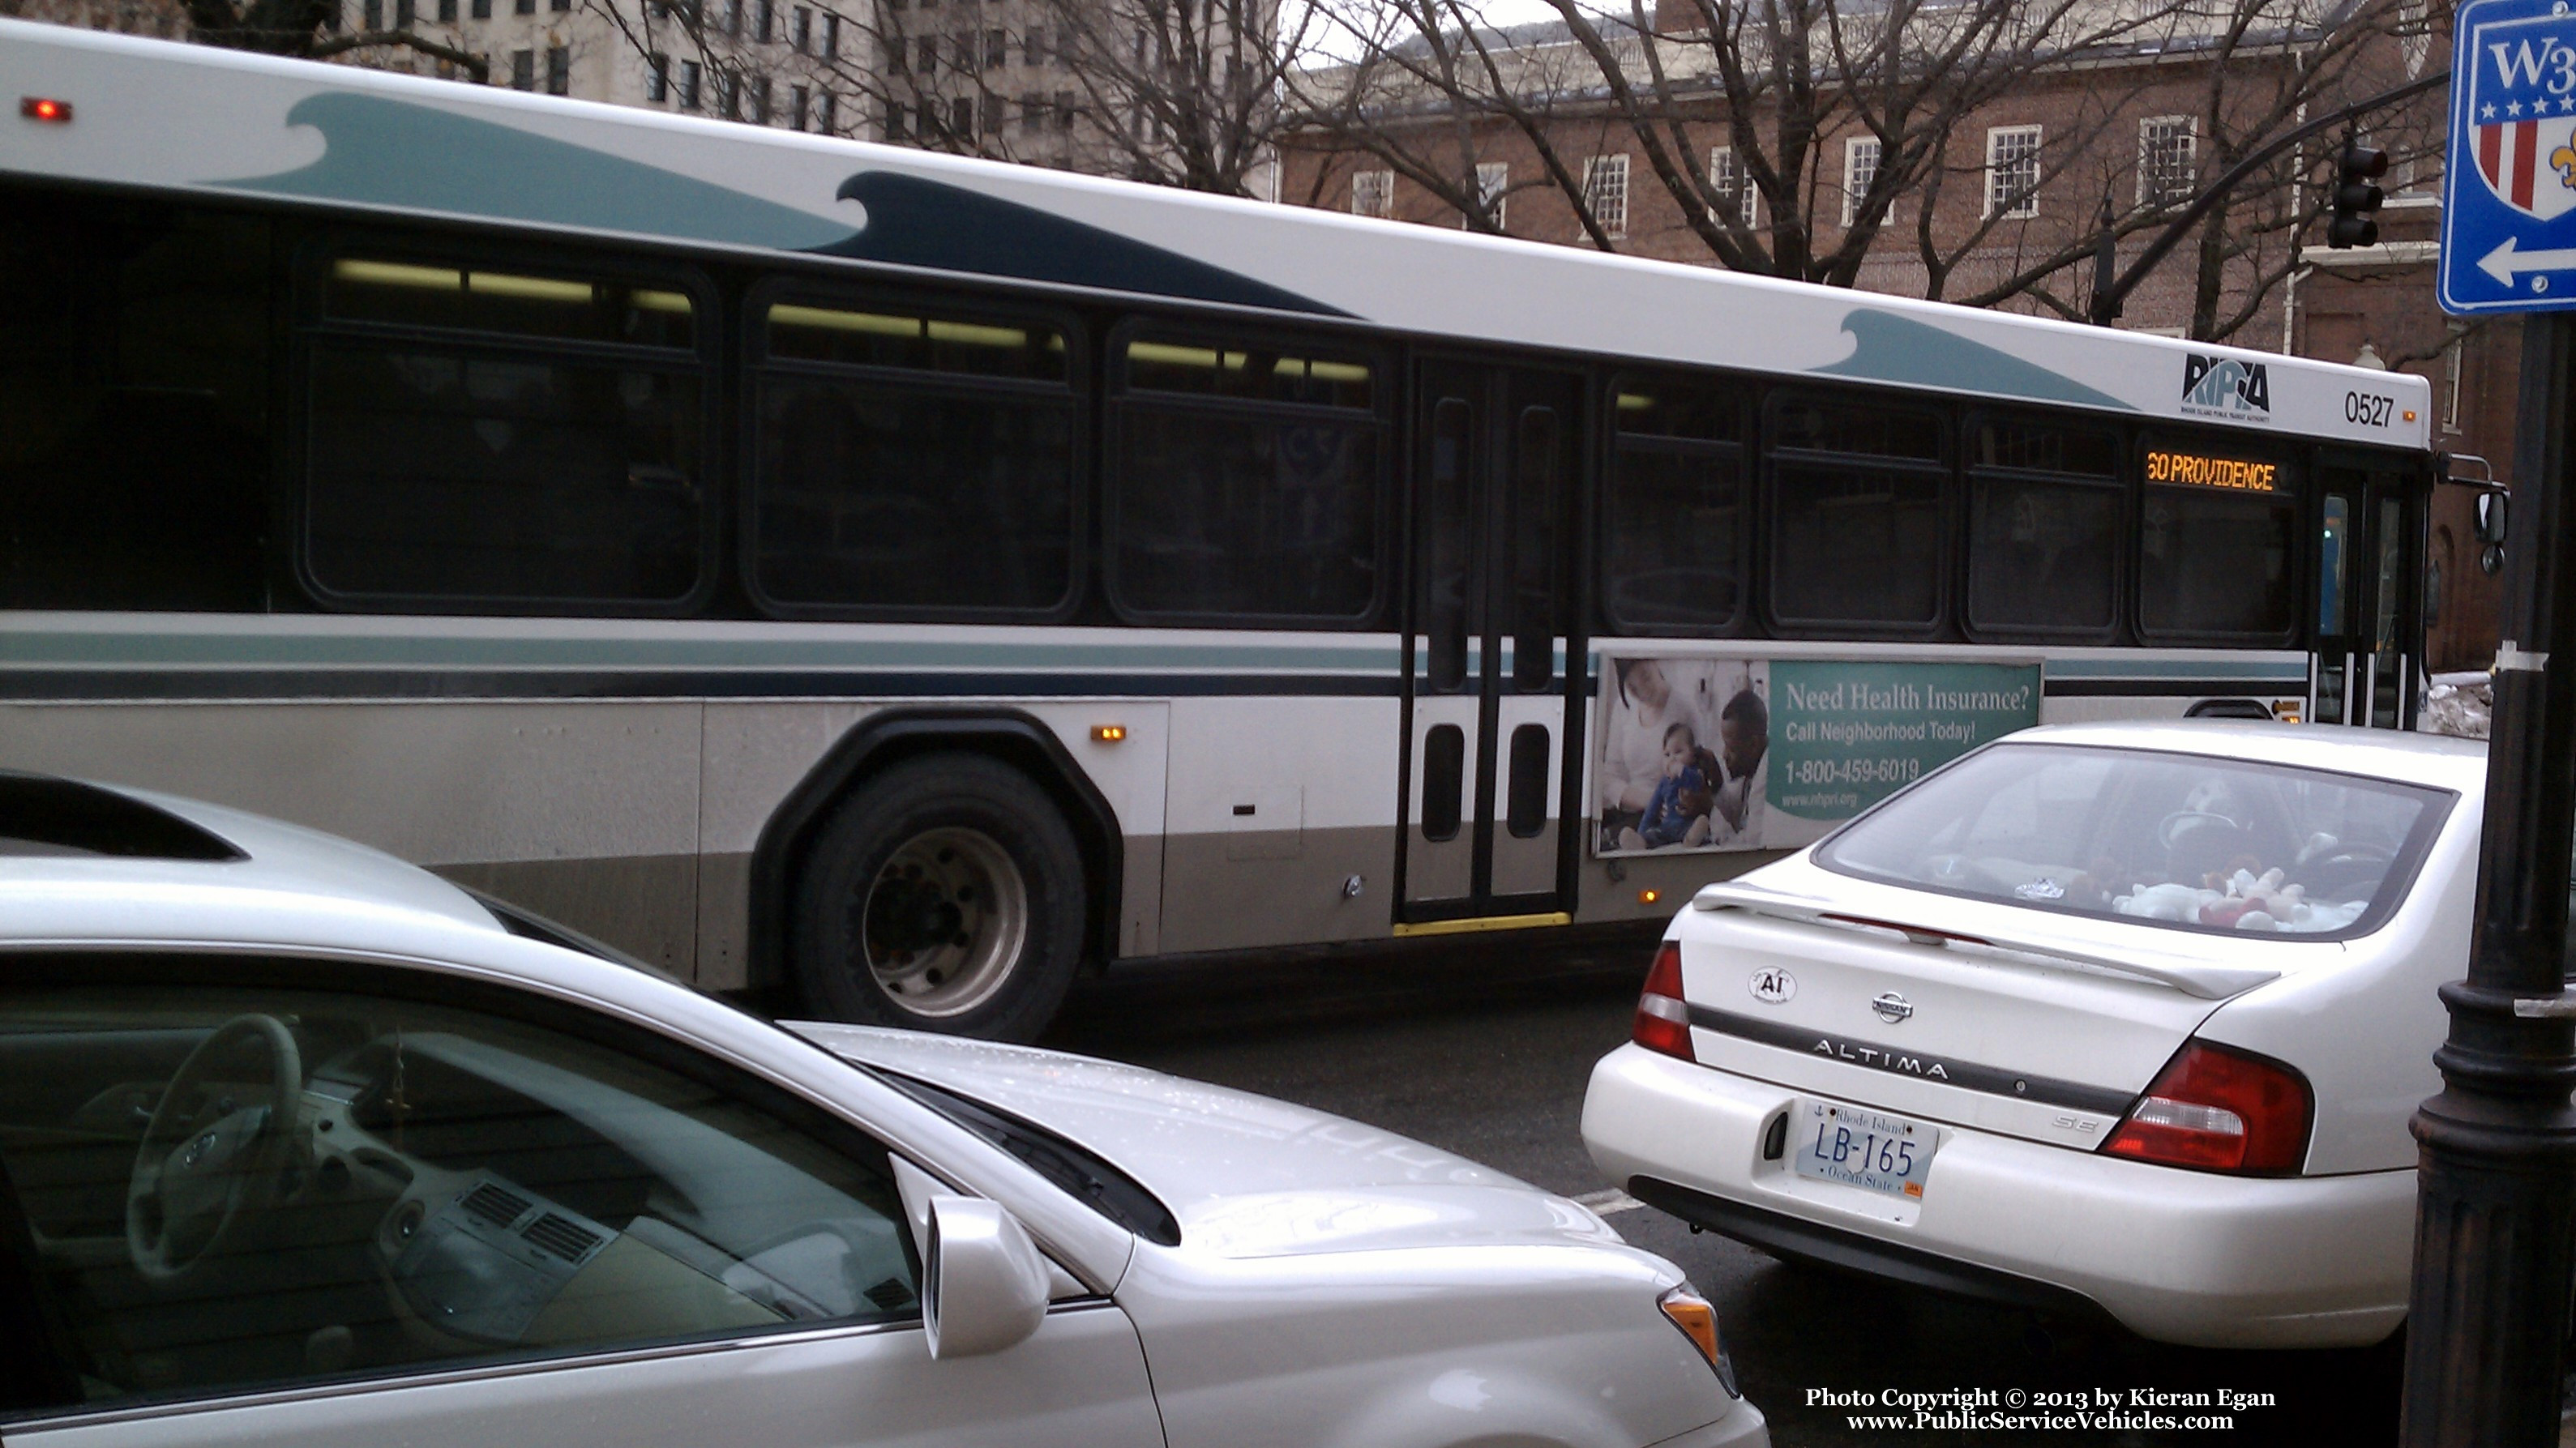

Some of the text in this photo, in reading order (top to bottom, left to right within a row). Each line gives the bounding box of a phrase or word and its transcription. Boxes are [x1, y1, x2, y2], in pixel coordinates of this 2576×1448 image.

[2345, 391, 2394, 428] 0527
[2170, 455, 2274, 491] PROVIDENCE
[1787, 682, 2029, 710] Need Health Insurance?
[1786, 720, 1975, 745] Call Neighborhood Today!
[1785, 758, 1919, 784] 1-800-459-6019
[1760, 973, 1782, 993] AI
[1813, 1039, 1949, 1080] ALTIMA
[1835, 1108, 1906, 1135] Rhode Island
[2052, 1115, 2099, 1134] SE
[1815, 1122, 1915, 1177] LB-165
[1828, 1166, 1893, 1192] Ocean State
